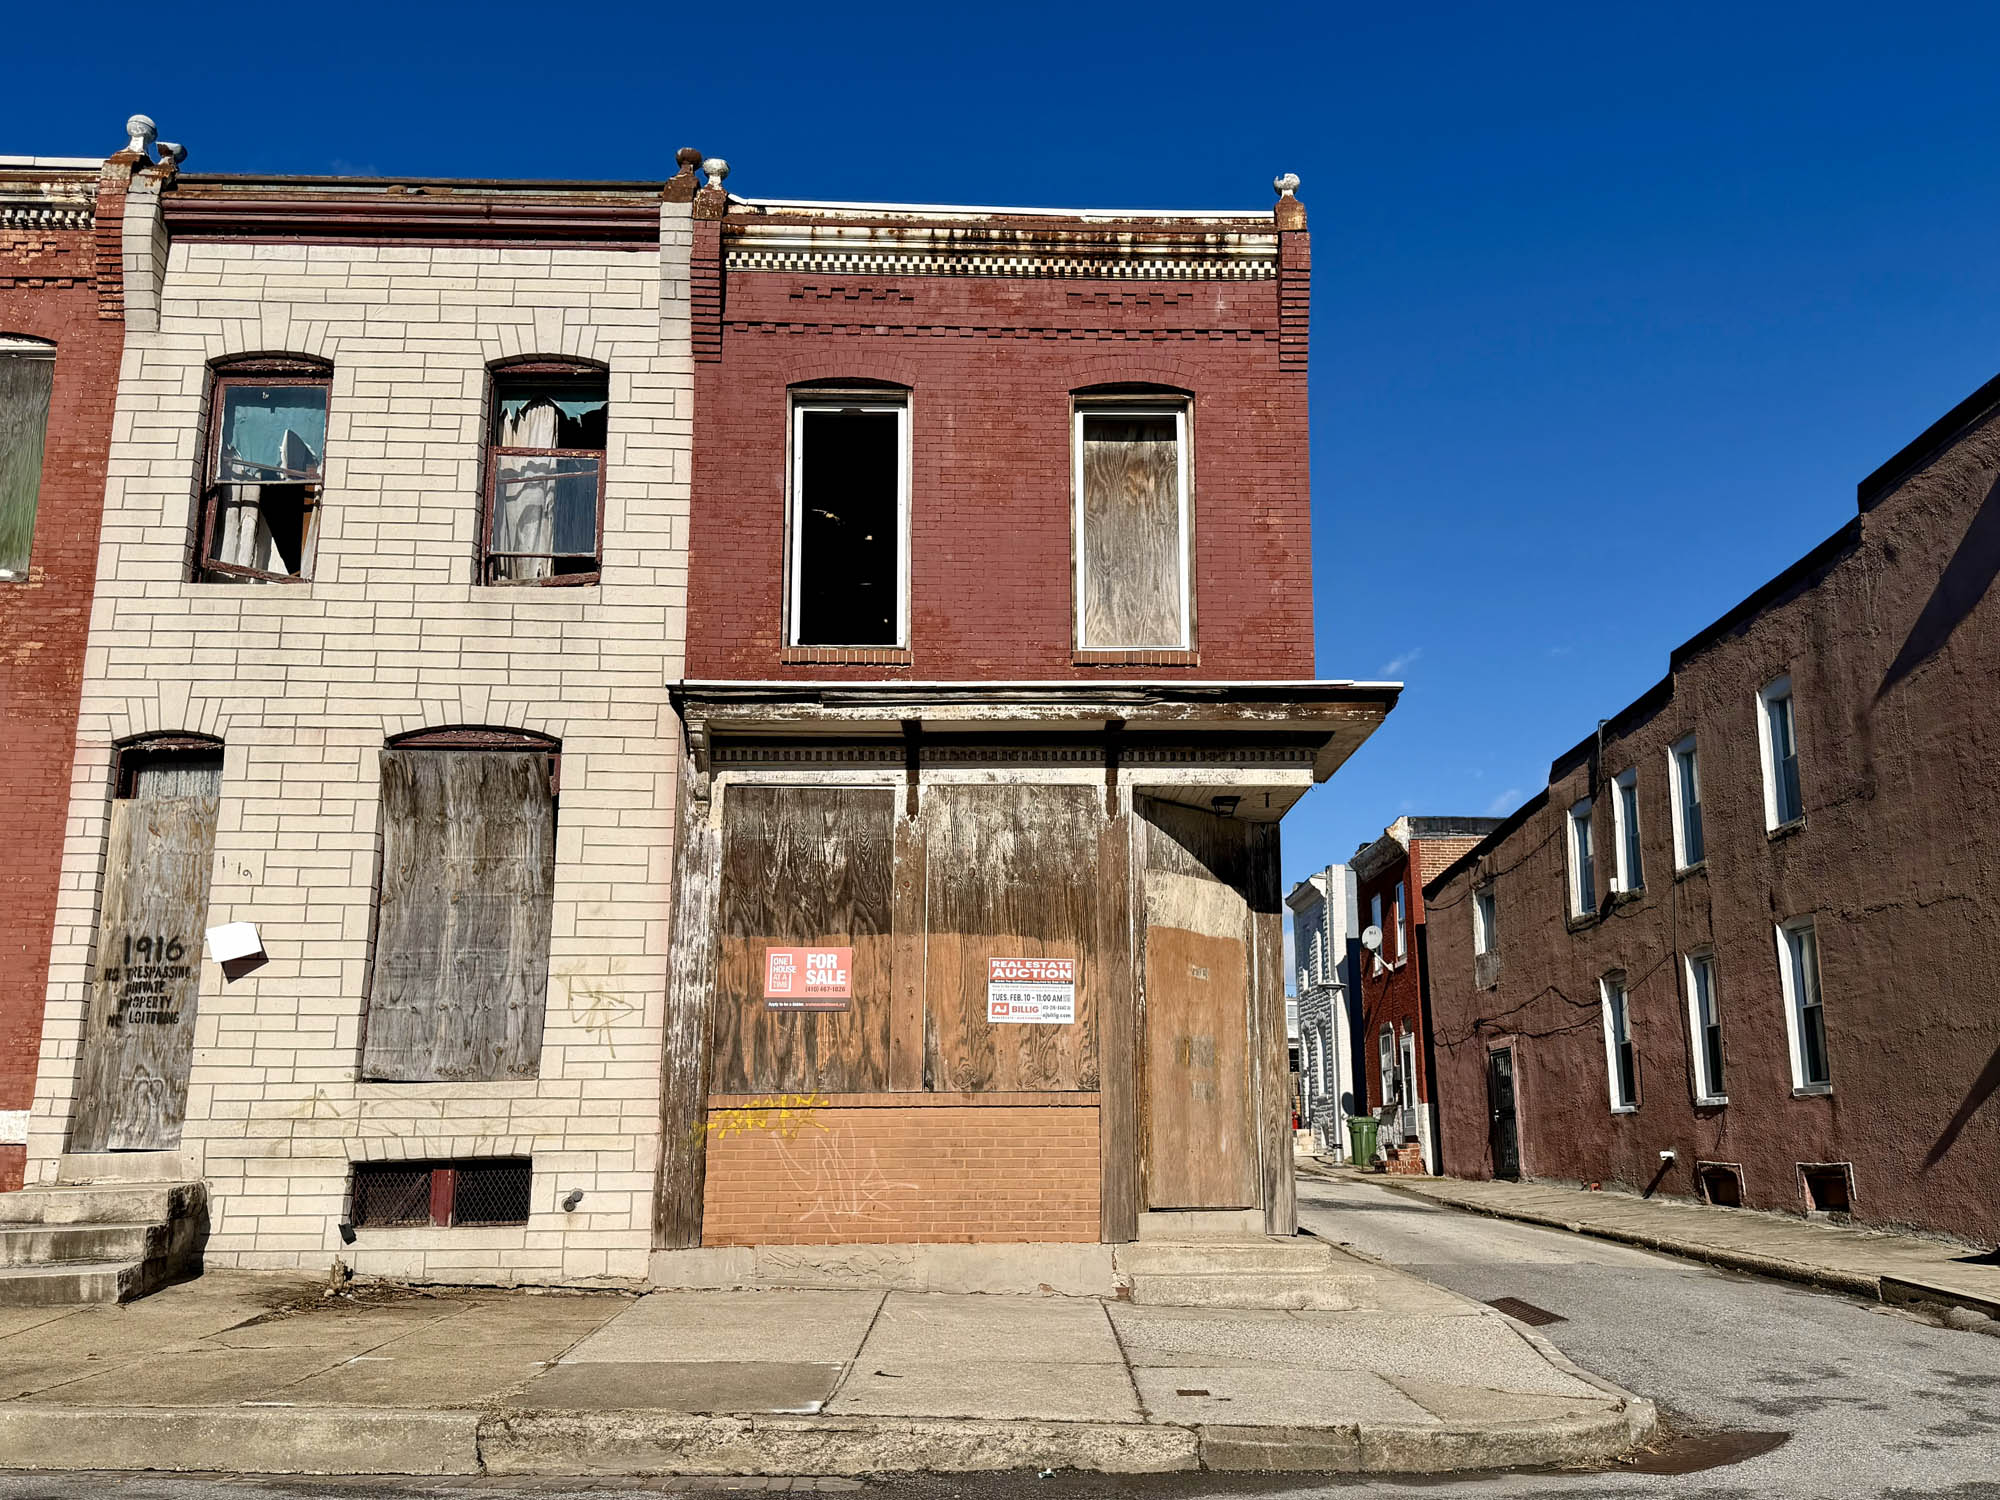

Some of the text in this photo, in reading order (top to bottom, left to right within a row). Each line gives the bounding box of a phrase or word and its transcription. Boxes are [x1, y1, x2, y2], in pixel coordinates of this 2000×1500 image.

[123, 934, 185, 965] 1916
[773, 957, 789, 965] ONE
[806, 953, 838, 969] FOR
[991, 960, 1073, 969] REAL ESTATE
[104, 965, 191, 982] NO TRESPASSING
[773, 965, 797, 973] HOUSE
[991, 967, 1073, 979] AUCTION
[805, 969, 846, 985] SALE
[125, 980, 166, 997] PRIVATE
[773, 980, 788, 988] TIME
[805, 985, 819, 993] (410)
[991, 993, 1009, 1001] TUES.
[1009, 993, 1023, 1002] FEB.
[1024, 993, 1031, 1002] 10
[1036, 994, 1051, 1002] 11:00
[1051, 994, 1063, 1002] AM
[118, 995, 172, 1012] PROPERTY
[993, 1004, 1008, 1013] AJ
[1011, 1005, 1039, 1014] BILLIG
